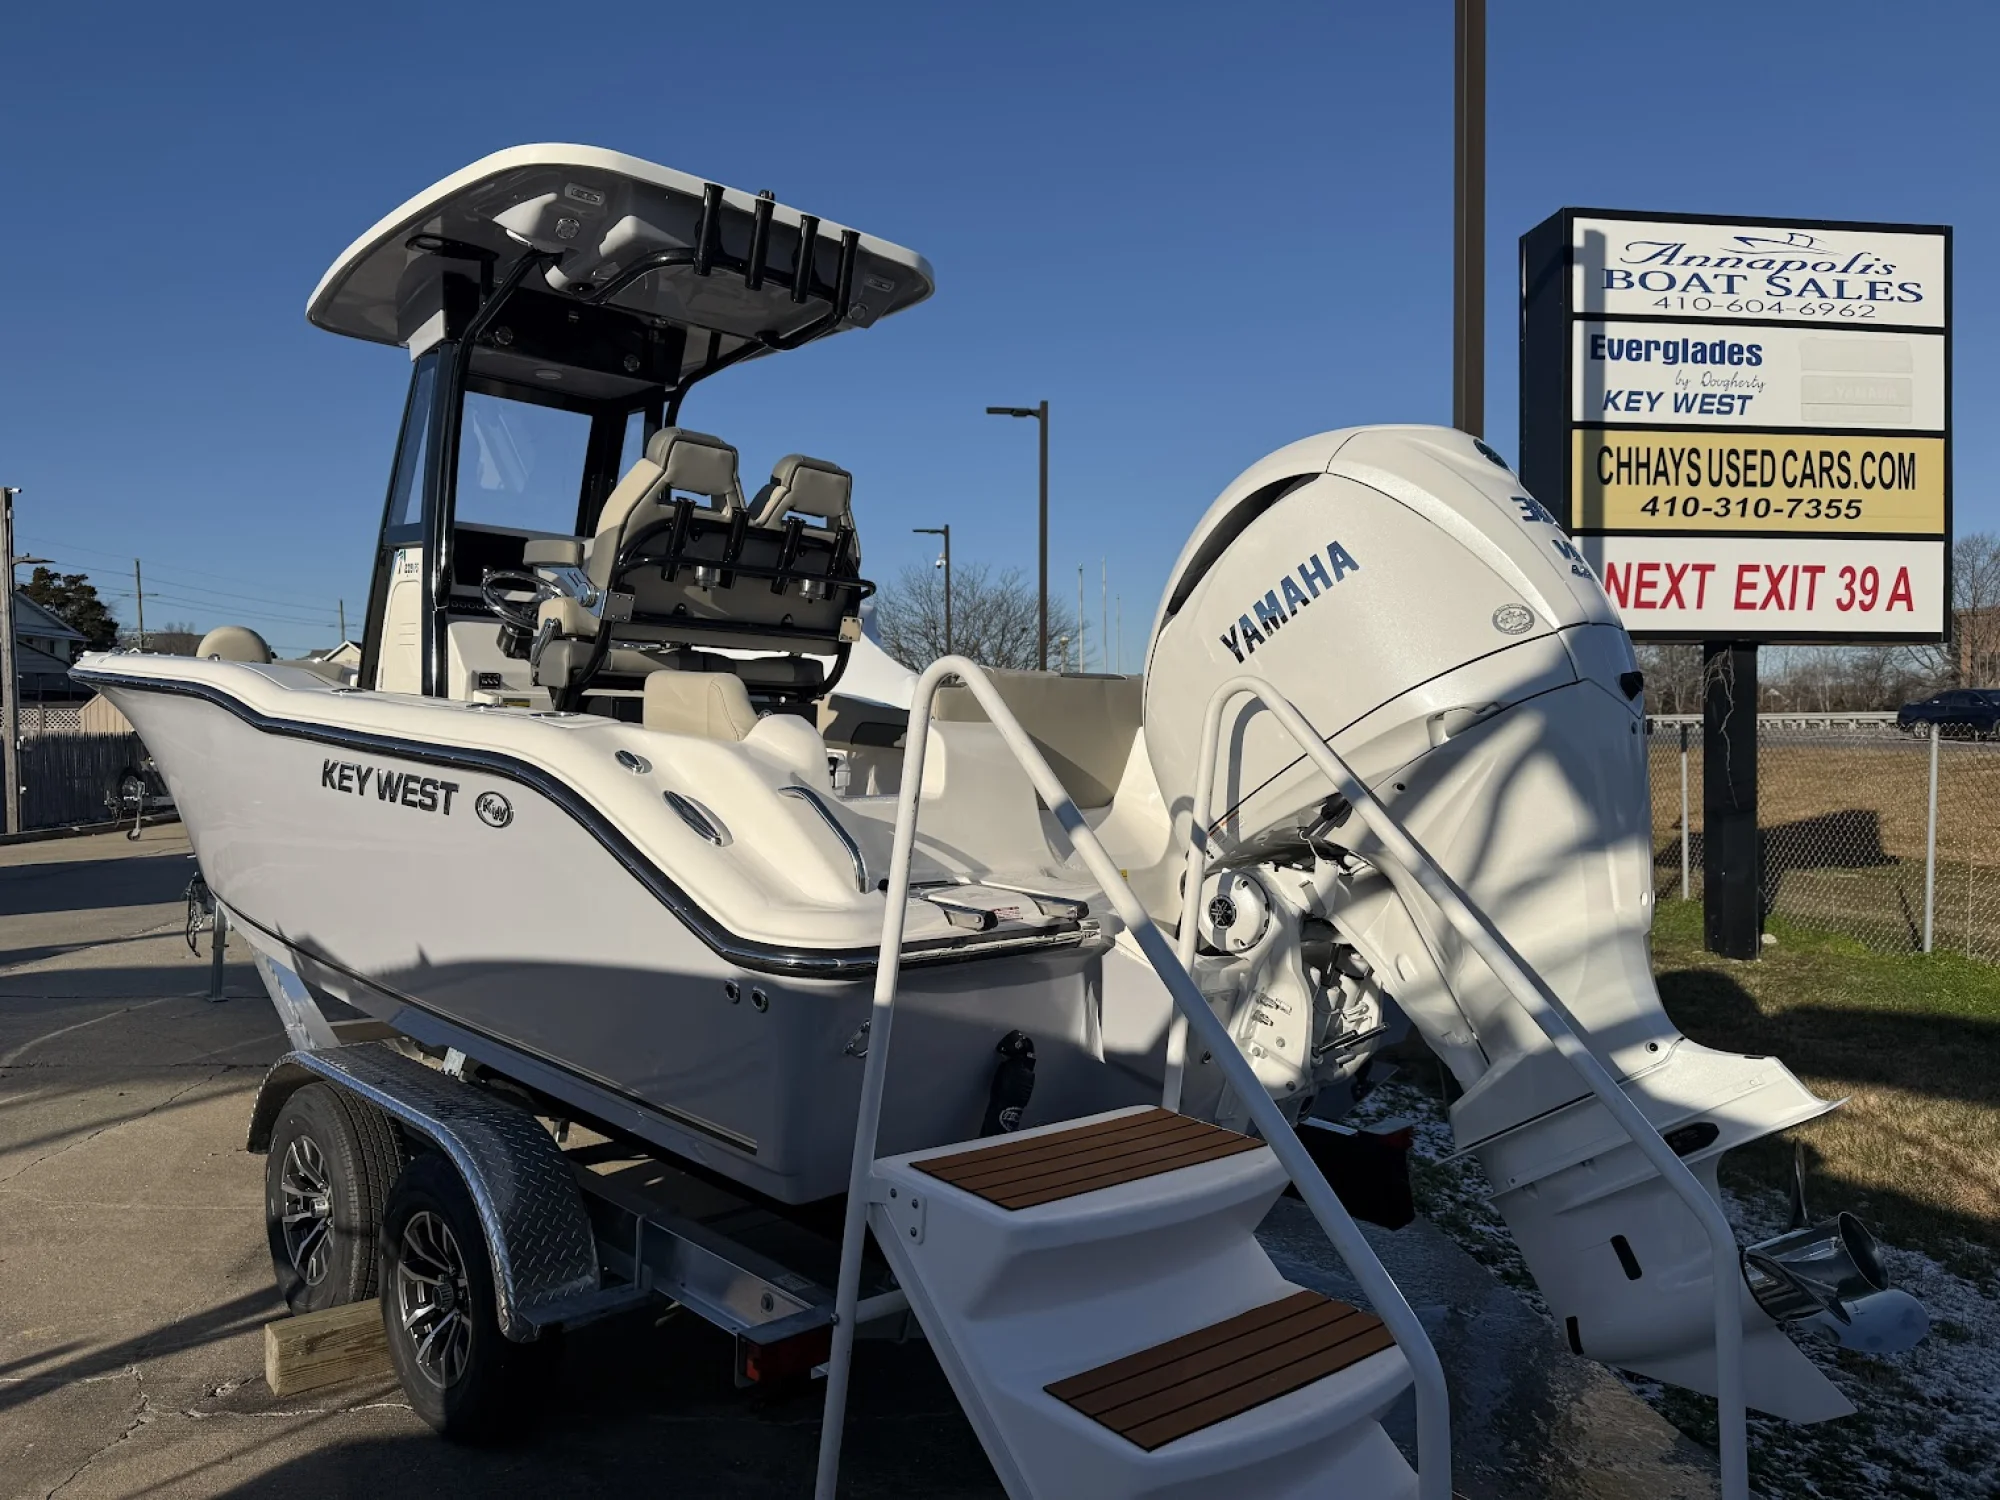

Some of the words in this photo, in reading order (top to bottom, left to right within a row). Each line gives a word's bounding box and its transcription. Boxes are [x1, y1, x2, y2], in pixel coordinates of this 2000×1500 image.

[1619, 240, 1897, 278] Annapolis
[1601, 268, 1748, 295] BOAT
[1765, 275, 1923, 303] SALES
[1652, 295, 1876, 318] 410-604-6962
[1590, 334, 1763, 366] Everglades
[1674, 369, 1692, 390] by
[1700, 370, 1767, 393] Dougherty
[1602, 389, 1664, 412] KEY
[1673, 391, 1754, 416] WEST
[1640, 495, 1863, 520] 410-310-7355
[1219, 540, 1360, 664] YAMAHA
[1605, 561, 1716, 610] NEXT
[1734, 563, 1826, 611] EXIT
[1836, 565, 1880, 612] 39
[1886, 565, 1914, 612] A
[321, 758, 374, 796] KEY
[377, 768, 460, 816] WEST
